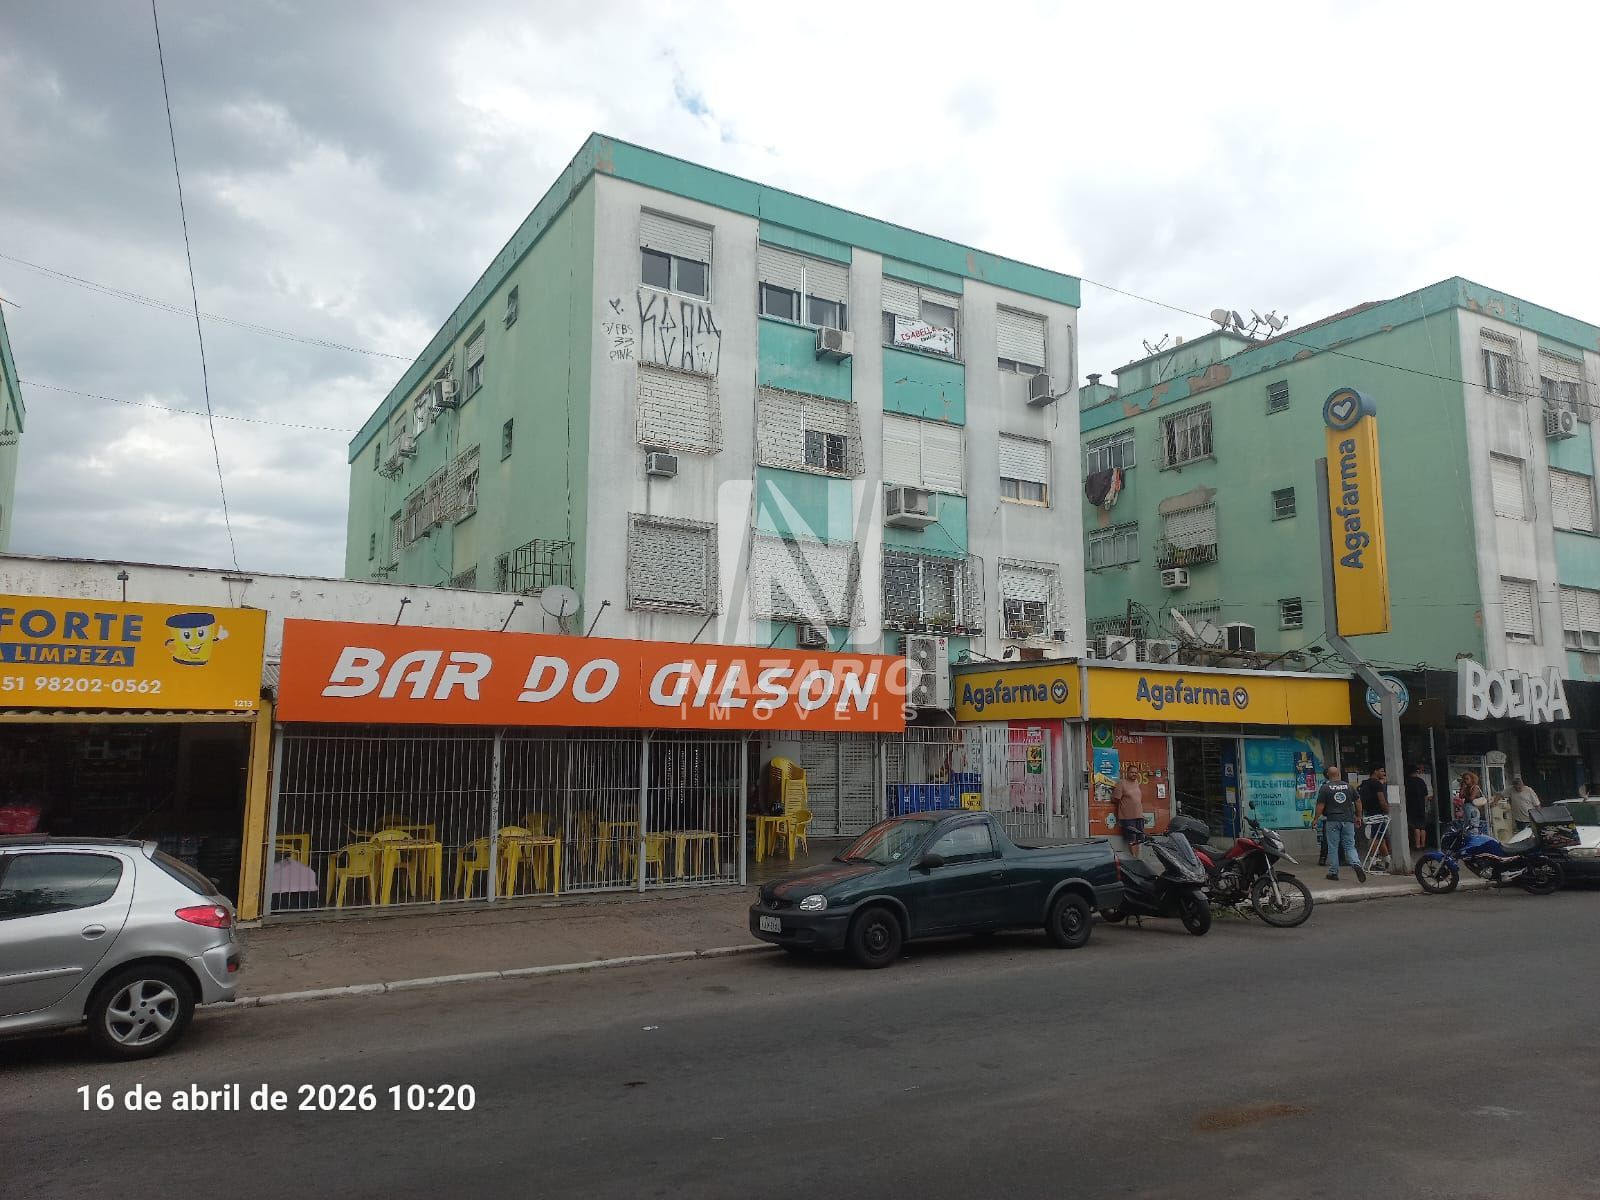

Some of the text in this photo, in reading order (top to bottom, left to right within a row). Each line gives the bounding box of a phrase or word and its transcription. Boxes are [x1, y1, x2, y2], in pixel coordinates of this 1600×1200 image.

[1336, 438, 1370, 570] Agafarma
[15, 645, 127, 665] LIMPEZA
[2, 676, 162, 694] 51 98202-0562
[321, 646, 878, 712] BAR DO GILSON
[962, 678, 1049, 712] Agafarma
[1136, 676, 1231, 710] Agafarma
[1457, 657, 1571, 725] BOEIRA
